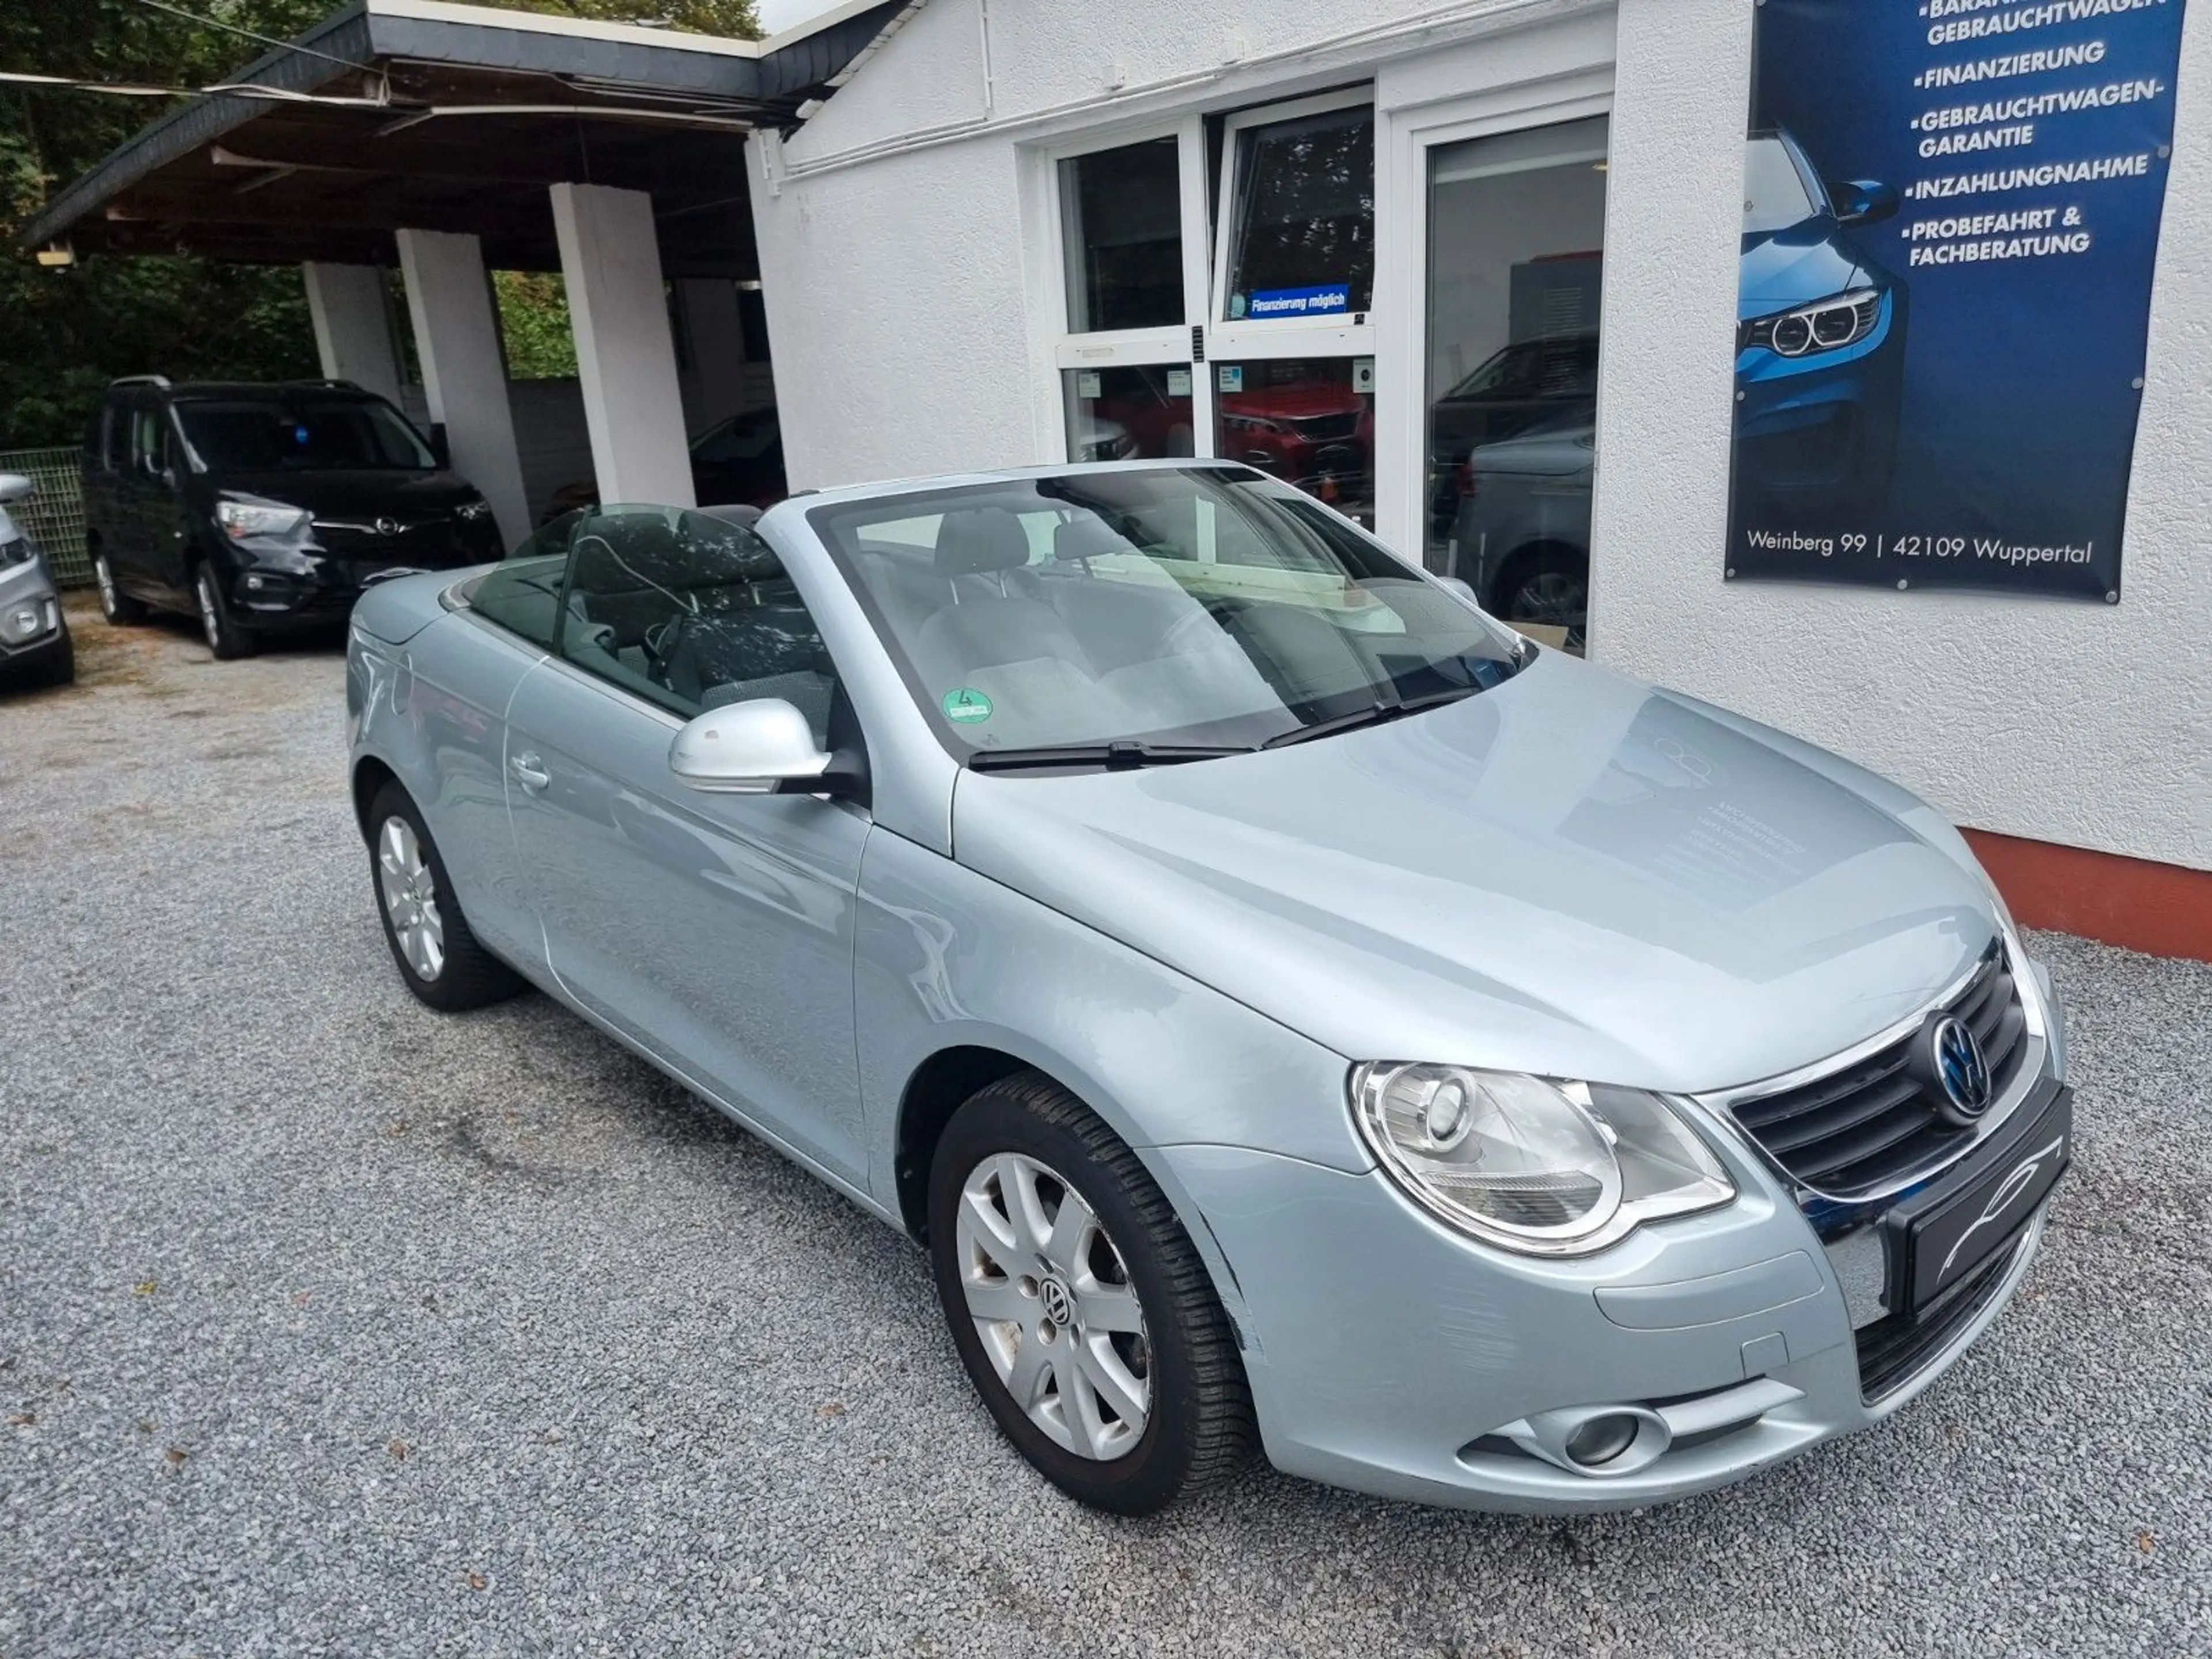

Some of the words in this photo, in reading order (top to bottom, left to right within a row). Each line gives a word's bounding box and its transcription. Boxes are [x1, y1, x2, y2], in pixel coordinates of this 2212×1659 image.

[1925, 41, 2105, 89] FINANZIERUNG
[1921, 79, 2165, 131] GEBRAUCHTWAGEN-
[1919, 124, 2033, 158] GARANTIE
[1915, 154, 2148, 199] INZAHLUNGNAHME
[1912, 209, 2056, 241] PROBEFAHRT
[2062, 206, 2081, 226] &
[1909, 234, 2090, 267] FACHBERATUNG
[1252, 298, 1306, 312] Finanzierung
[1309, 293, 1345, 309] möglich
[1747, 530, 1833, 556] Weinberg
[1841, 534, 1867, 553] 99
[1893, 537, 1965, 558] 42109
[1974, 539, 2092, 567] Wuppertal
